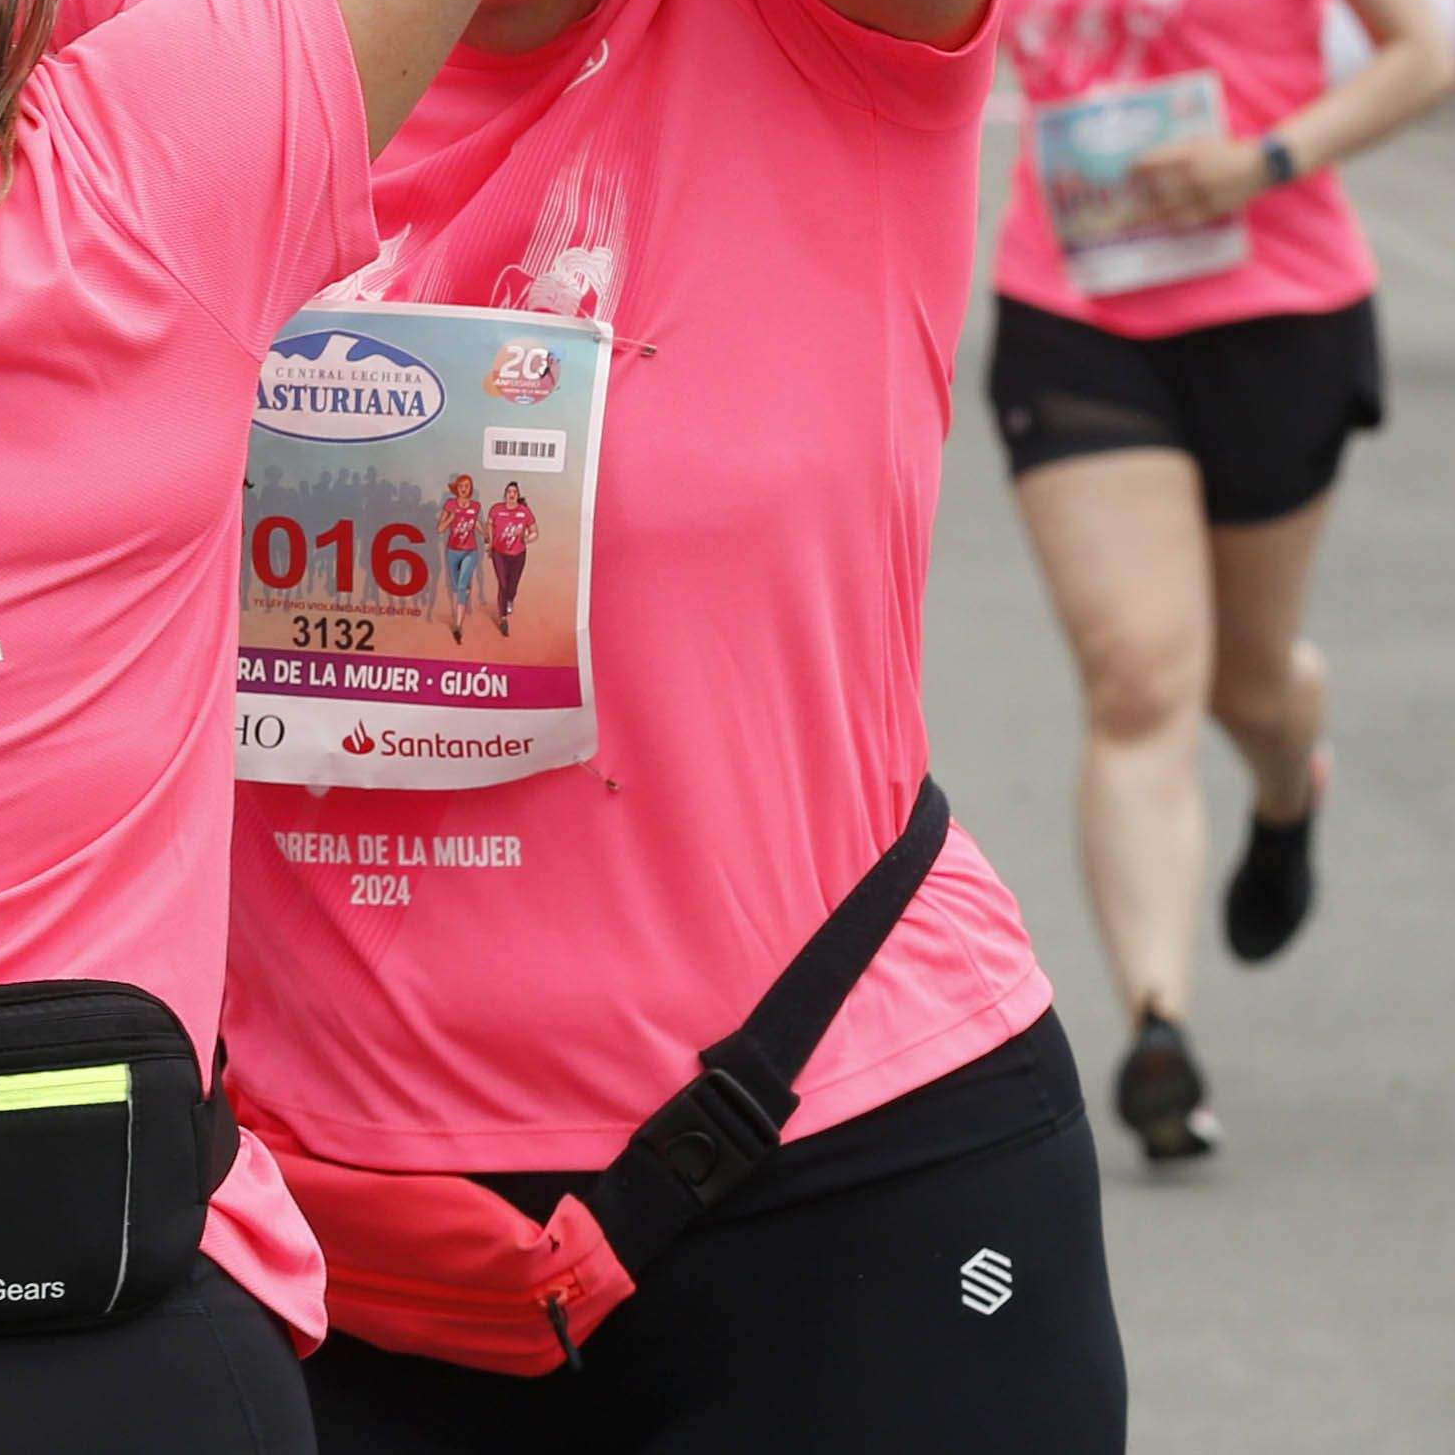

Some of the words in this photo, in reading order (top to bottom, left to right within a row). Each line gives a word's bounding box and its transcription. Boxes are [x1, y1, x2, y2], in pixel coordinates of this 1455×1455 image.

[276, 367, 344, 381] CENTRAL
[351, 370, 422, 384] LECHERA
[251, 515, 429, 597] 016
[292, 615, 375, 651] 3132
[274, 659, 302, 684] DE
[309, 662, 337, 687] LA
[345, 664, 419, 693] MUJER
[440, 666, 508, 698] GIJÓN
[381, 729, 534, 759] Santander
[357, 834, 389, 865] DE
[398, 835, 427, 866] LA
[432, 836, 522, 867] MUJER
[350, 873, 412, 906] 2024
